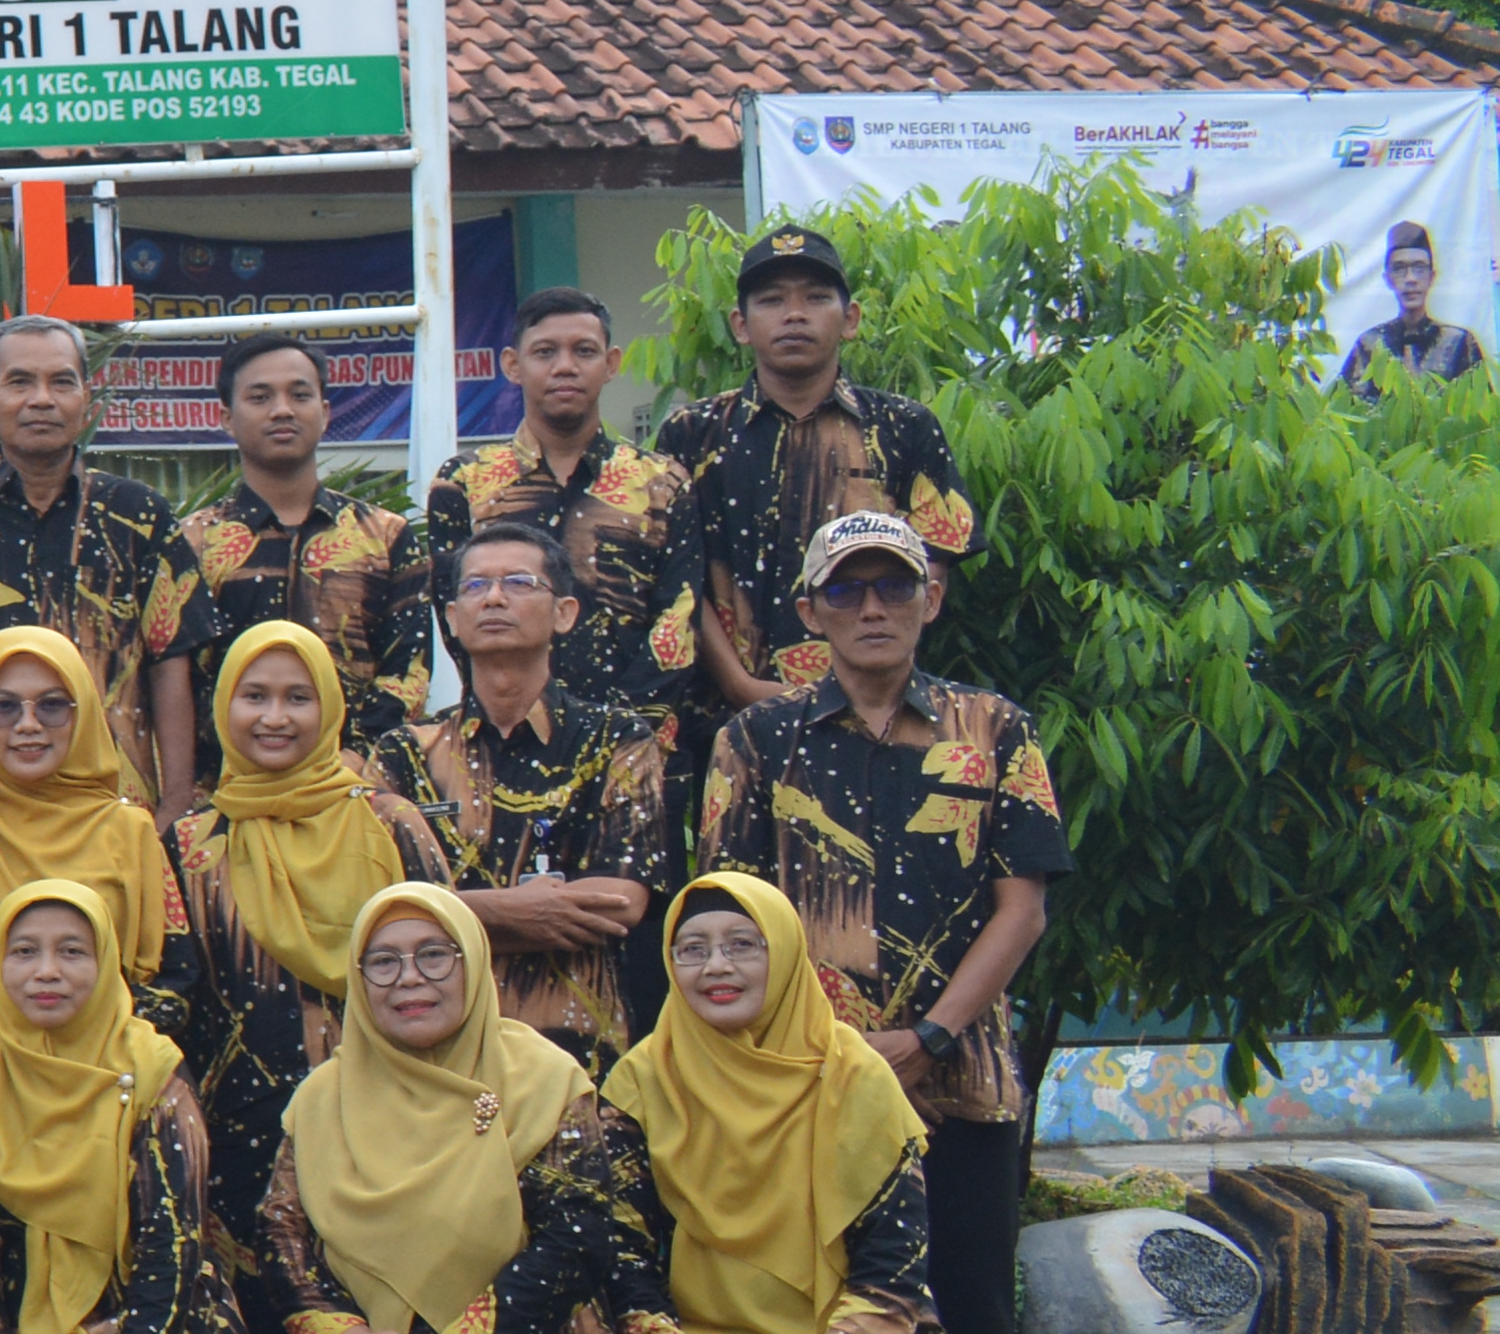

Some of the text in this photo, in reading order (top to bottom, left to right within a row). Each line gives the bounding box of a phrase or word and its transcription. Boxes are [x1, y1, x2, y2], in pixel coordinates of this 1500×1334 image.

[65, 13, 85, 56] 1
[110, 6, 300, 54] TALANG
[863, 122, 1031, 135] SMP NEGERI 1 TALANG
[1074, 125, 1181, 142] BerAKHLAK
[890, 139, 1006, 150] KABUPATEN TEGAL
[1388, 148, 1437, 159] TEGAL
